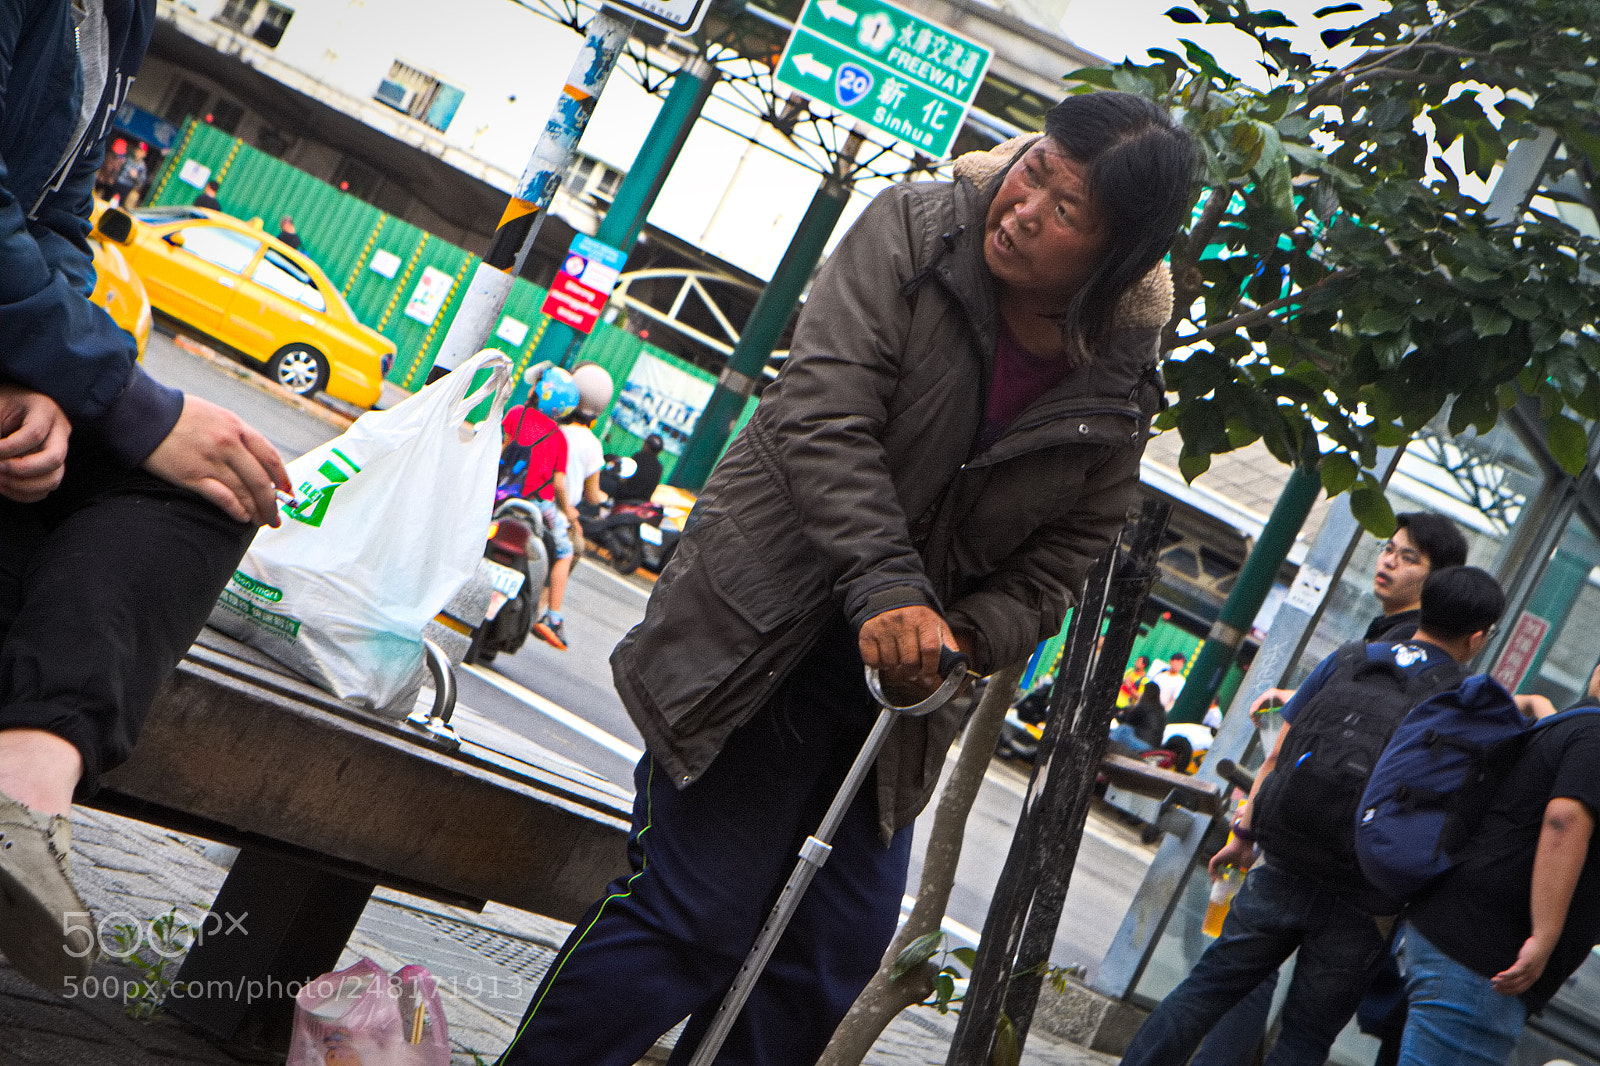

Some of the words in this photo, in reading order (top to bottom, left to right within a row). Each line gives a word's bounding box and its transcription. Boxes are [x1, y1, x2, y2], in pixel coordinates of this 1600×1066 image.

[840, 69, 868, 94] 20
[887, 46, 969, 96] FREEWAY
[873, 105, 934, 147] Sinhua
